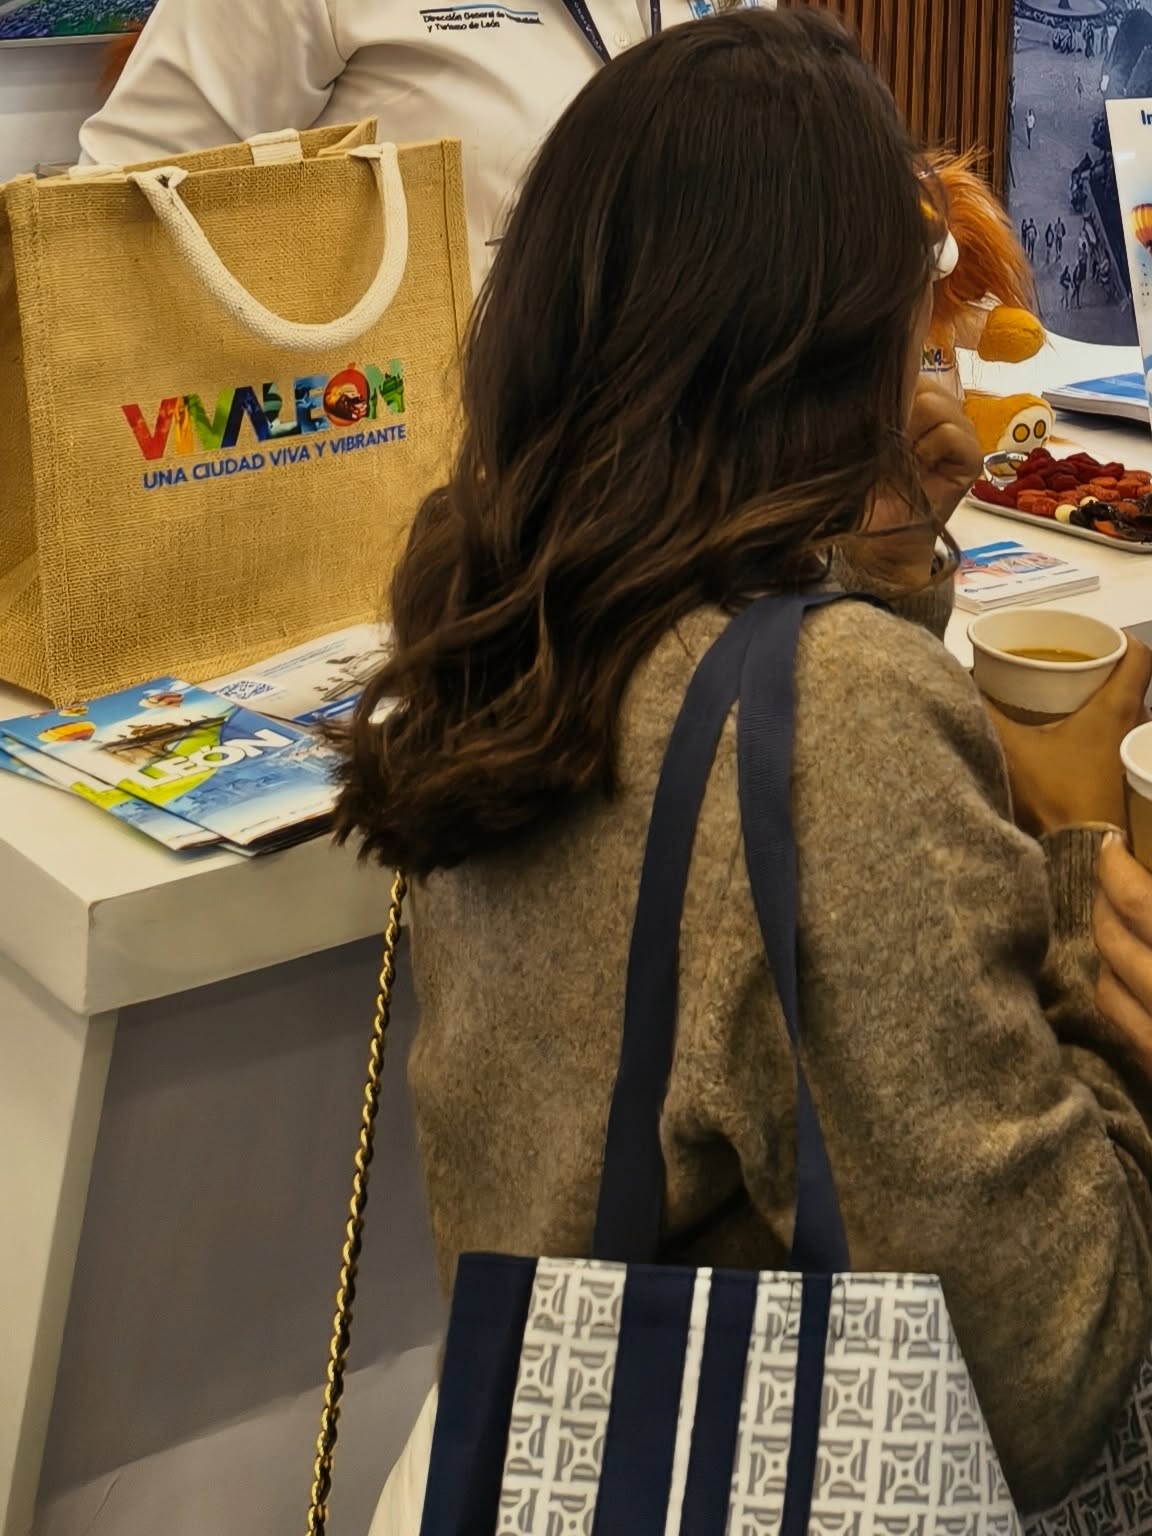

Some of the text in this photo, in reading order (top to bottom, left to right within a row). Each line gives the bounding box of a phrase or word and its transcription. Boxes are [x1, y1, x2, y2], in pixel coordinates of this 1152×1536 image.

[142, 423, 407, 490] UNA CIUDAD VIVA Y VIBRANTE
